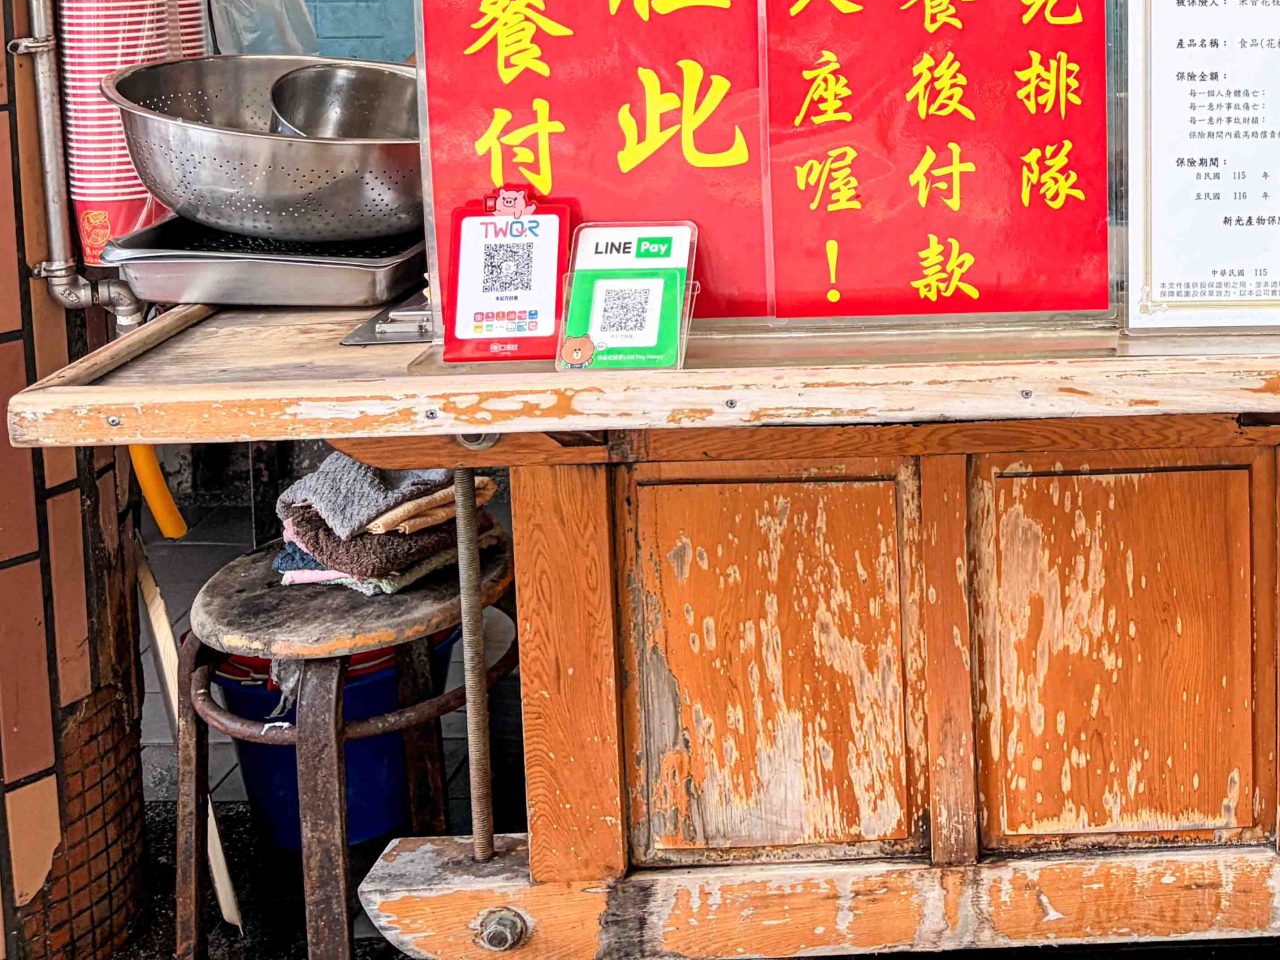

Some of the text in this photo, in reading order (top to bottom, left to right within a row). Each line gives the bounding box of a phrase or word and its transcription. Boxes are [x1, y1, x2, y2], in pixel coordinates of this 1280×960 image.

[480, 220, 540, 238] TWQR
[594, 241, 669, 255] LINE Pay
